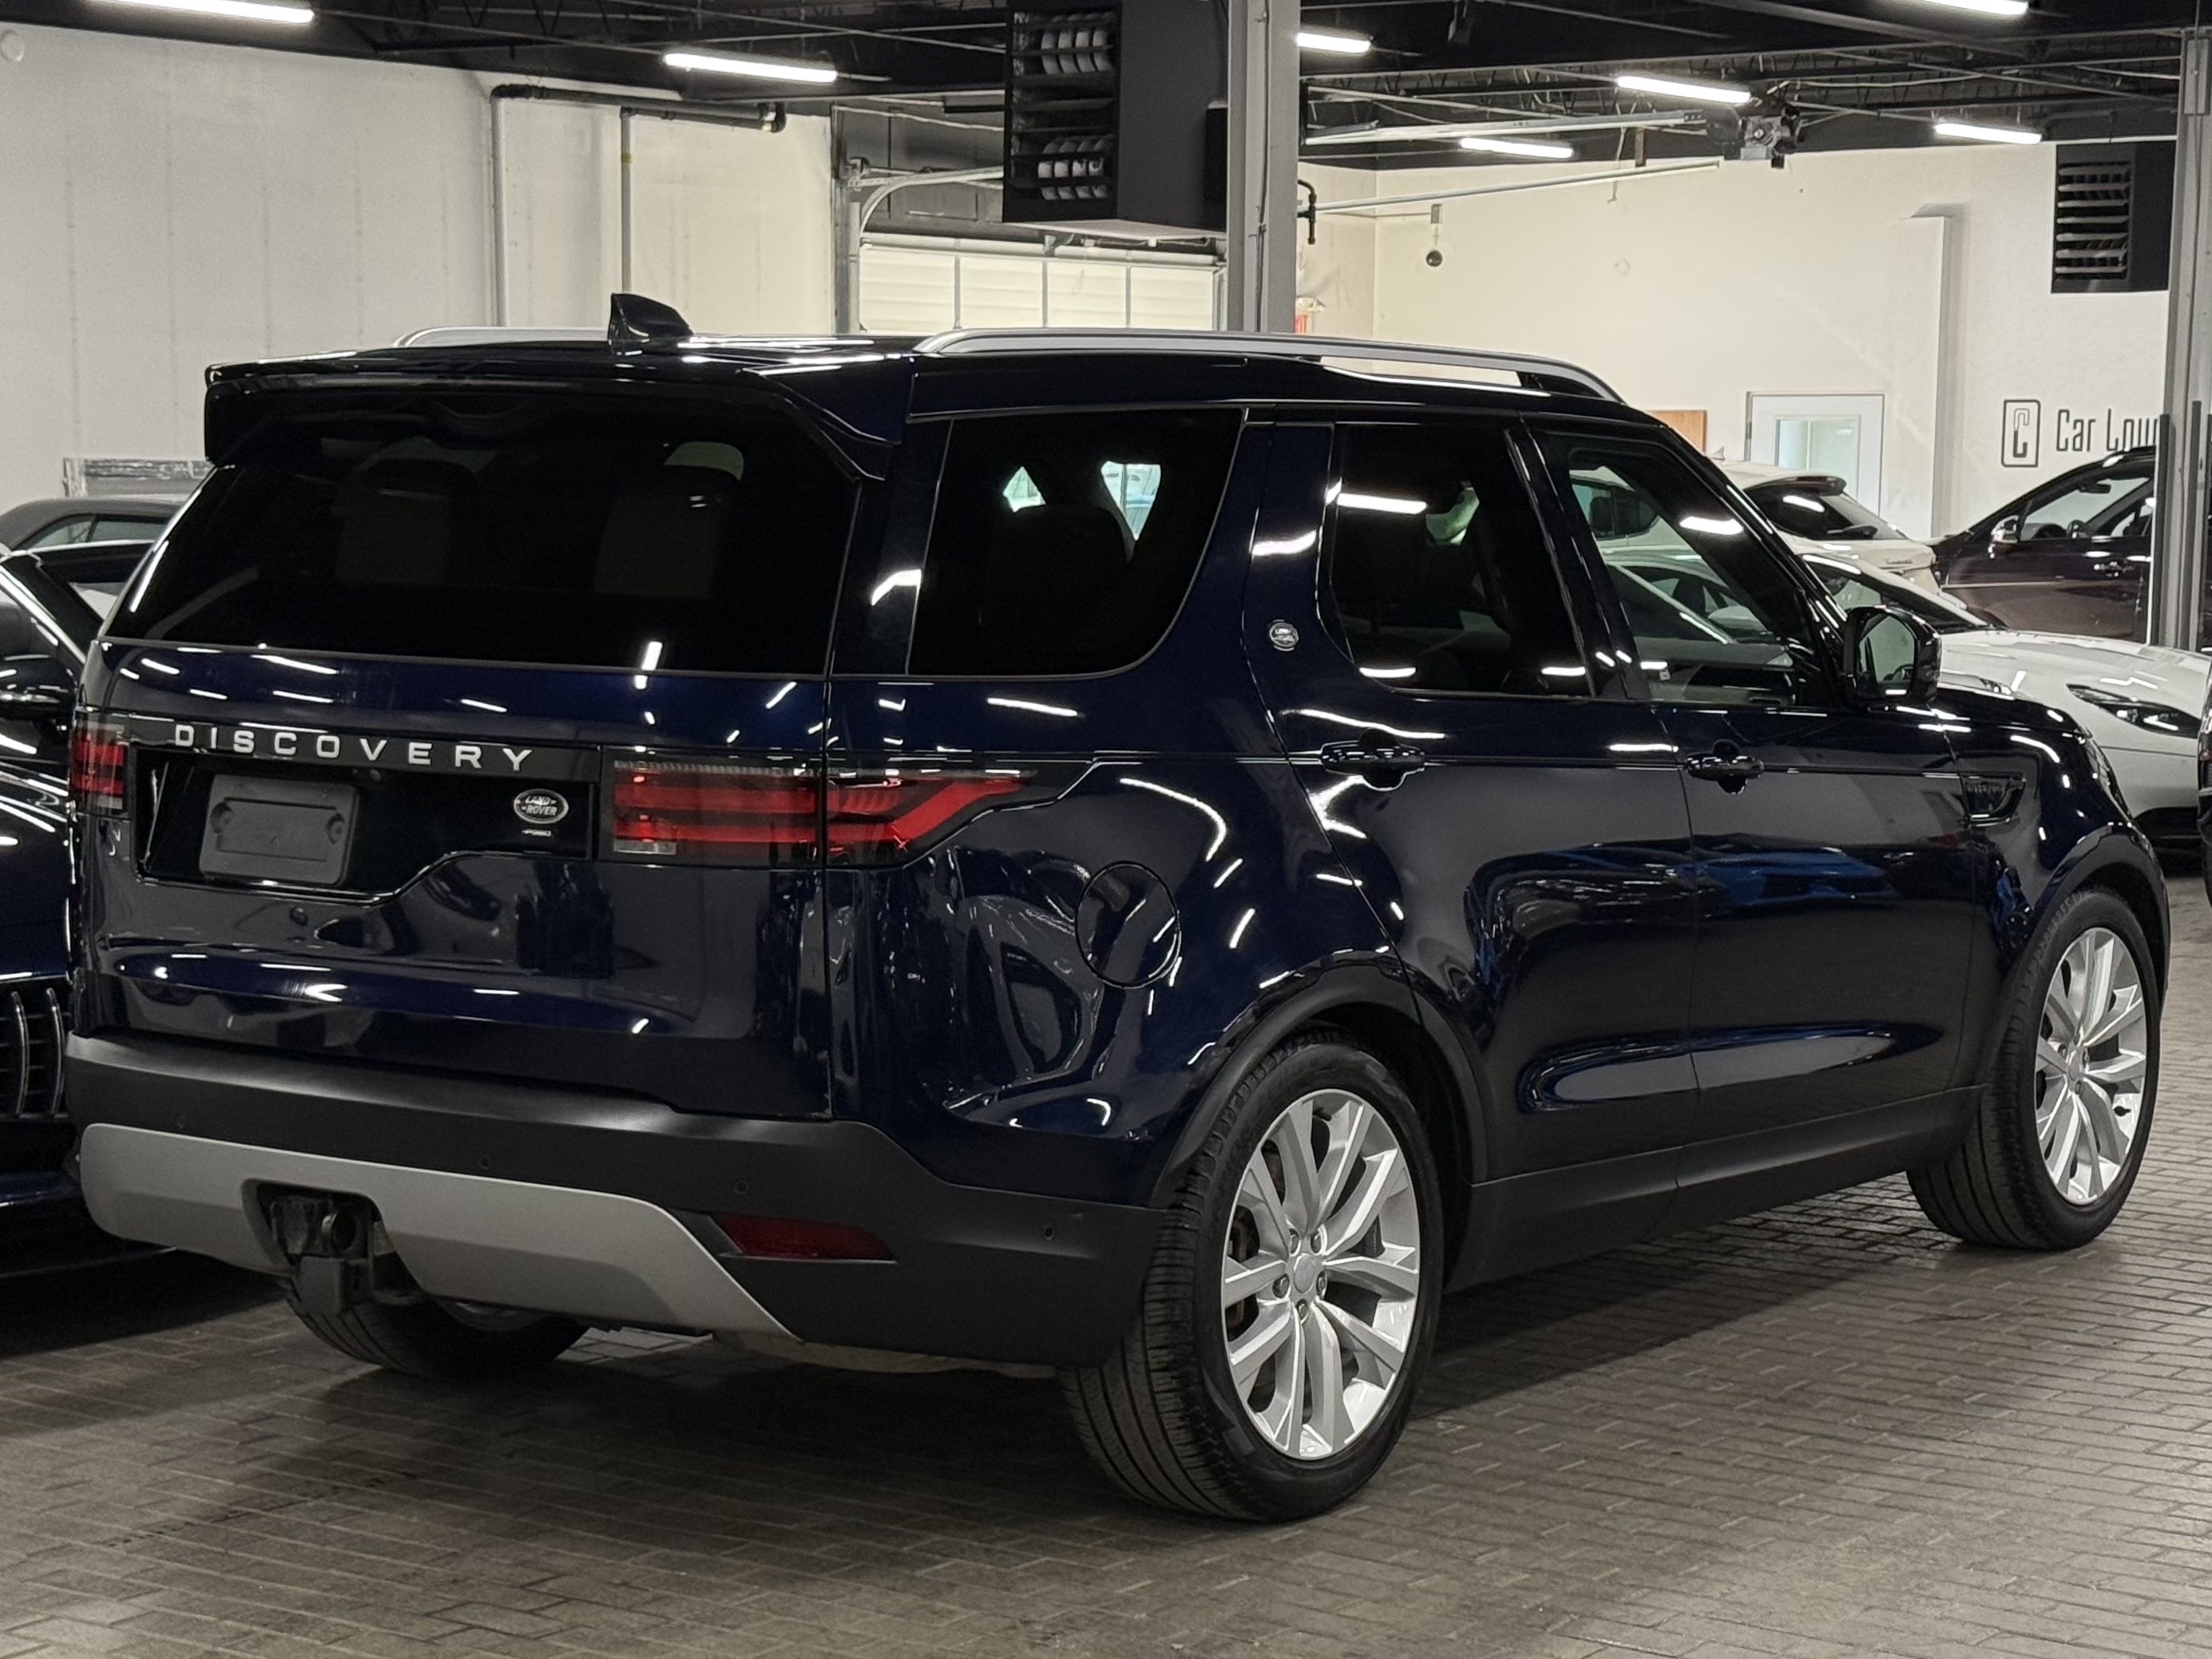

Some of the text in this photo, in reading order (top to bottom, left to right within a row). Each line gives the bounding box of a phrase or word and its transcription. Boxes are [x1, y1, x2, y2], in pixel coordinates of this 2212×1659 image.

[2055, 409, 2097, 453] Car
[174, 723, 533, 772] DISCOVERY
[526, 804, 558, 816] ROVER
